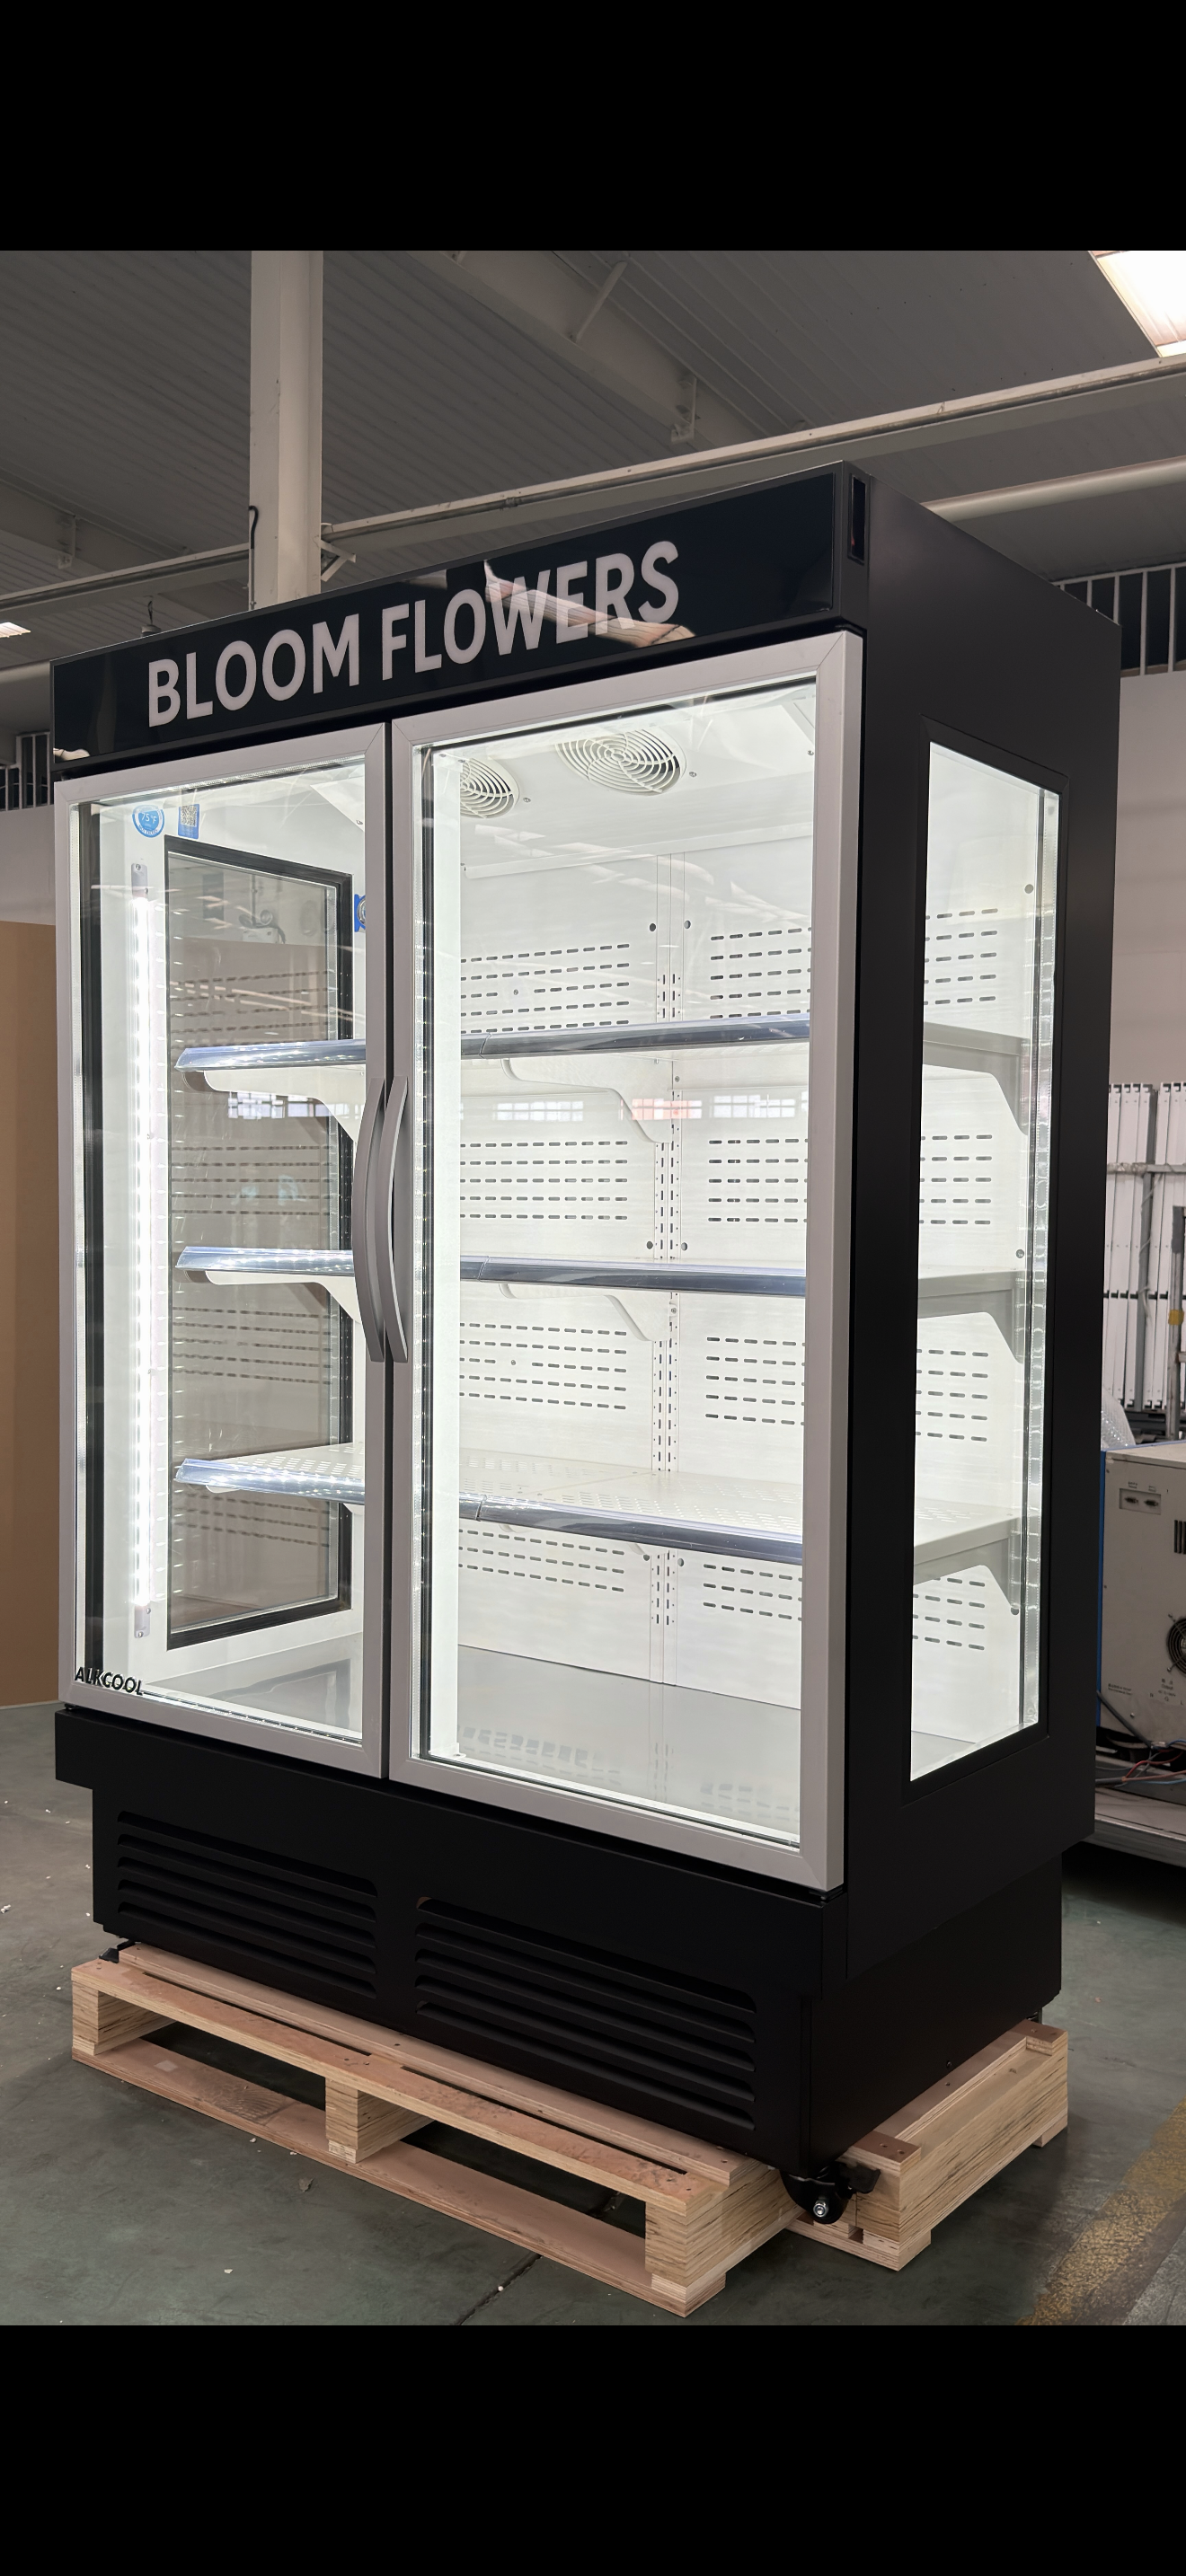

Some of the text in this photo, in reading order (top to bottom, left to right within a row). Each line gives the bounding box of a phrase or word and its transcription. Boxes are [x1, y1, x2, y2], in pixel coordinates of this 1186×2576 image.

[147, 540, 680, 728] BLOOM FLOWERS
[74, 1666, 144, 1696] ALKCOOL
